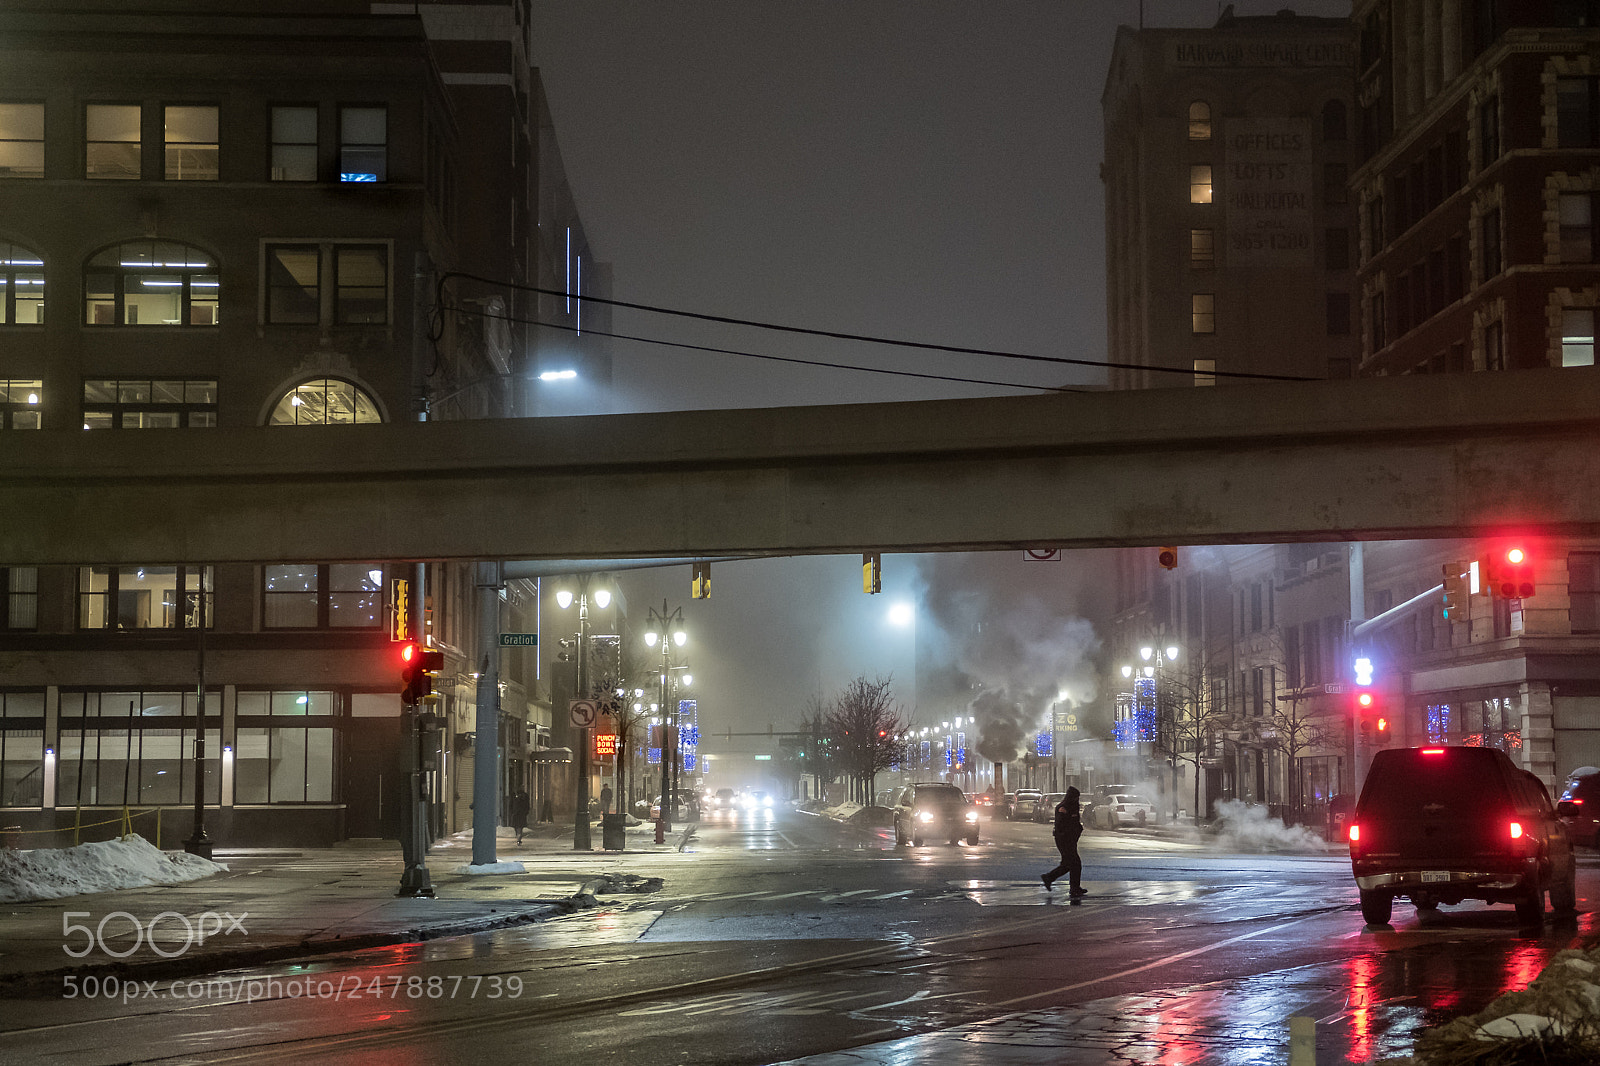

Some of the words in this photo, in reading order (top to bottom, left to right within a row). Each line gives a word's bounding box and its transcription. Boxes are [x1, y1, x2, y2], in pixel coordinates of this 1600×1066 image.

[1234, 133, 1302, 151] OFFICES
[1234, 162, 1288, 180] LOFTS
[504, 634, 534, 645] Gratiot
